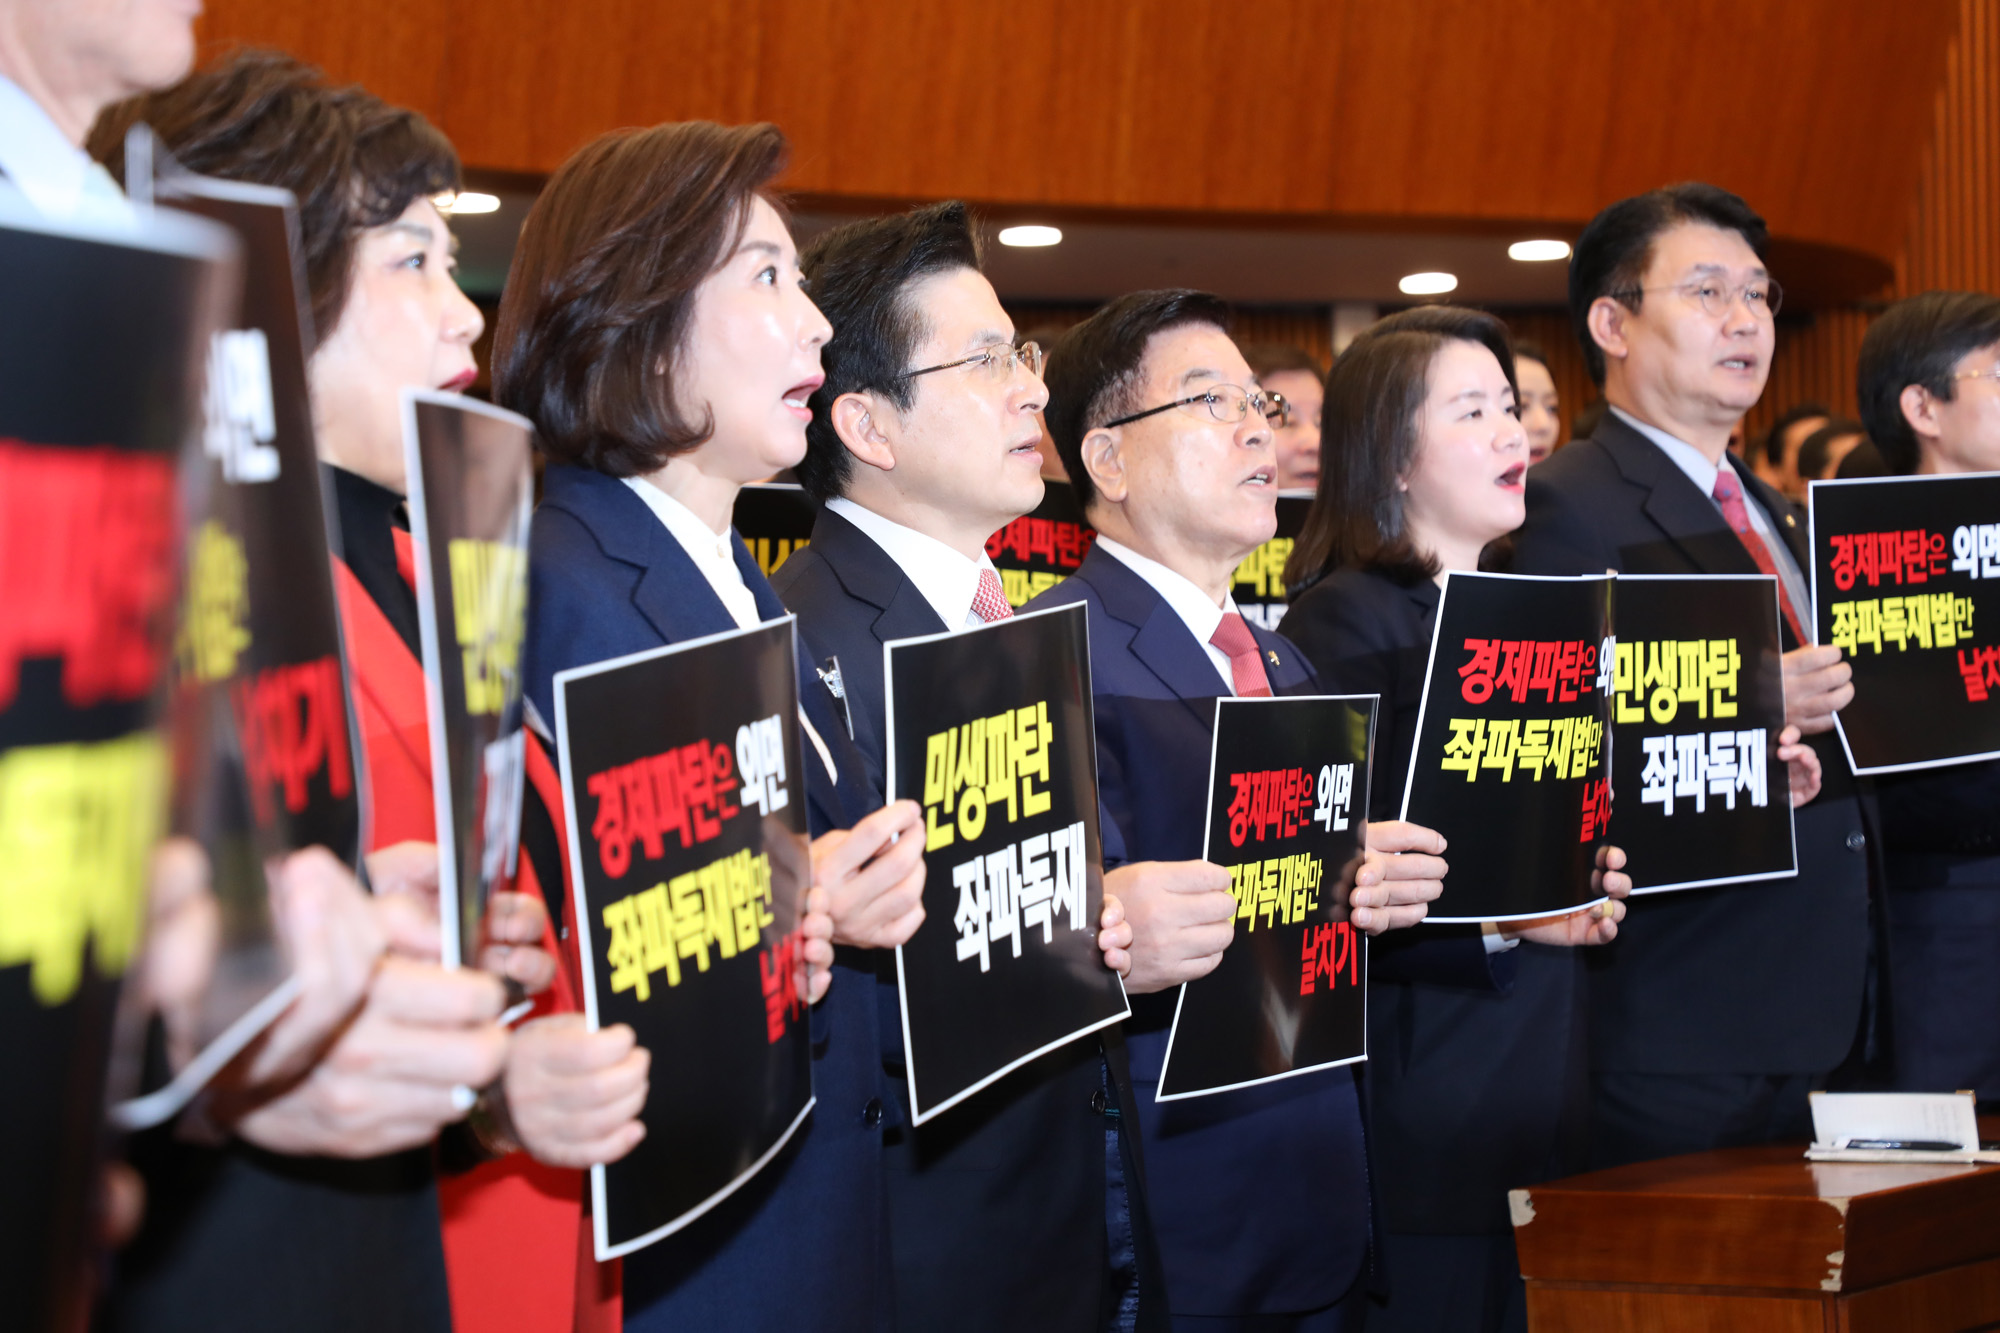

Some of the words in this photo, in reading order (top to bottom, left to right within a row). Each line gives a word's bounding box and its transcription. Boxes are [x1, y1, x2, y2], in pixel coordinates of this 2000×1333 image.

[1830, 528, 1948, 591] 경제파탄은
[1831, 592, 1975, 657] 좌파독재법만
[1458, 636, 1597, 704] 경제파탄은
[1614, 638, 1741, 724] 민생파탄
[922, 701, 1053, 852] 민생파탄
[1441, 714, 1603, 783] 좌파독재법만
[1641, 728, 1768, 816] 좌파독재
[587, 738, 740, 879] 경제파탄은
[735, 714, 788, 817] 외면
[1227, 766, 1314, 848] 경제파탄은
[1313, 763, 1355, 833] 외면
[602, 847, 774, 1002] 좌파독재법만
[952, 821, 1088, 973] 좌파독재
[1300, 919, 1358, 996] 날치기
